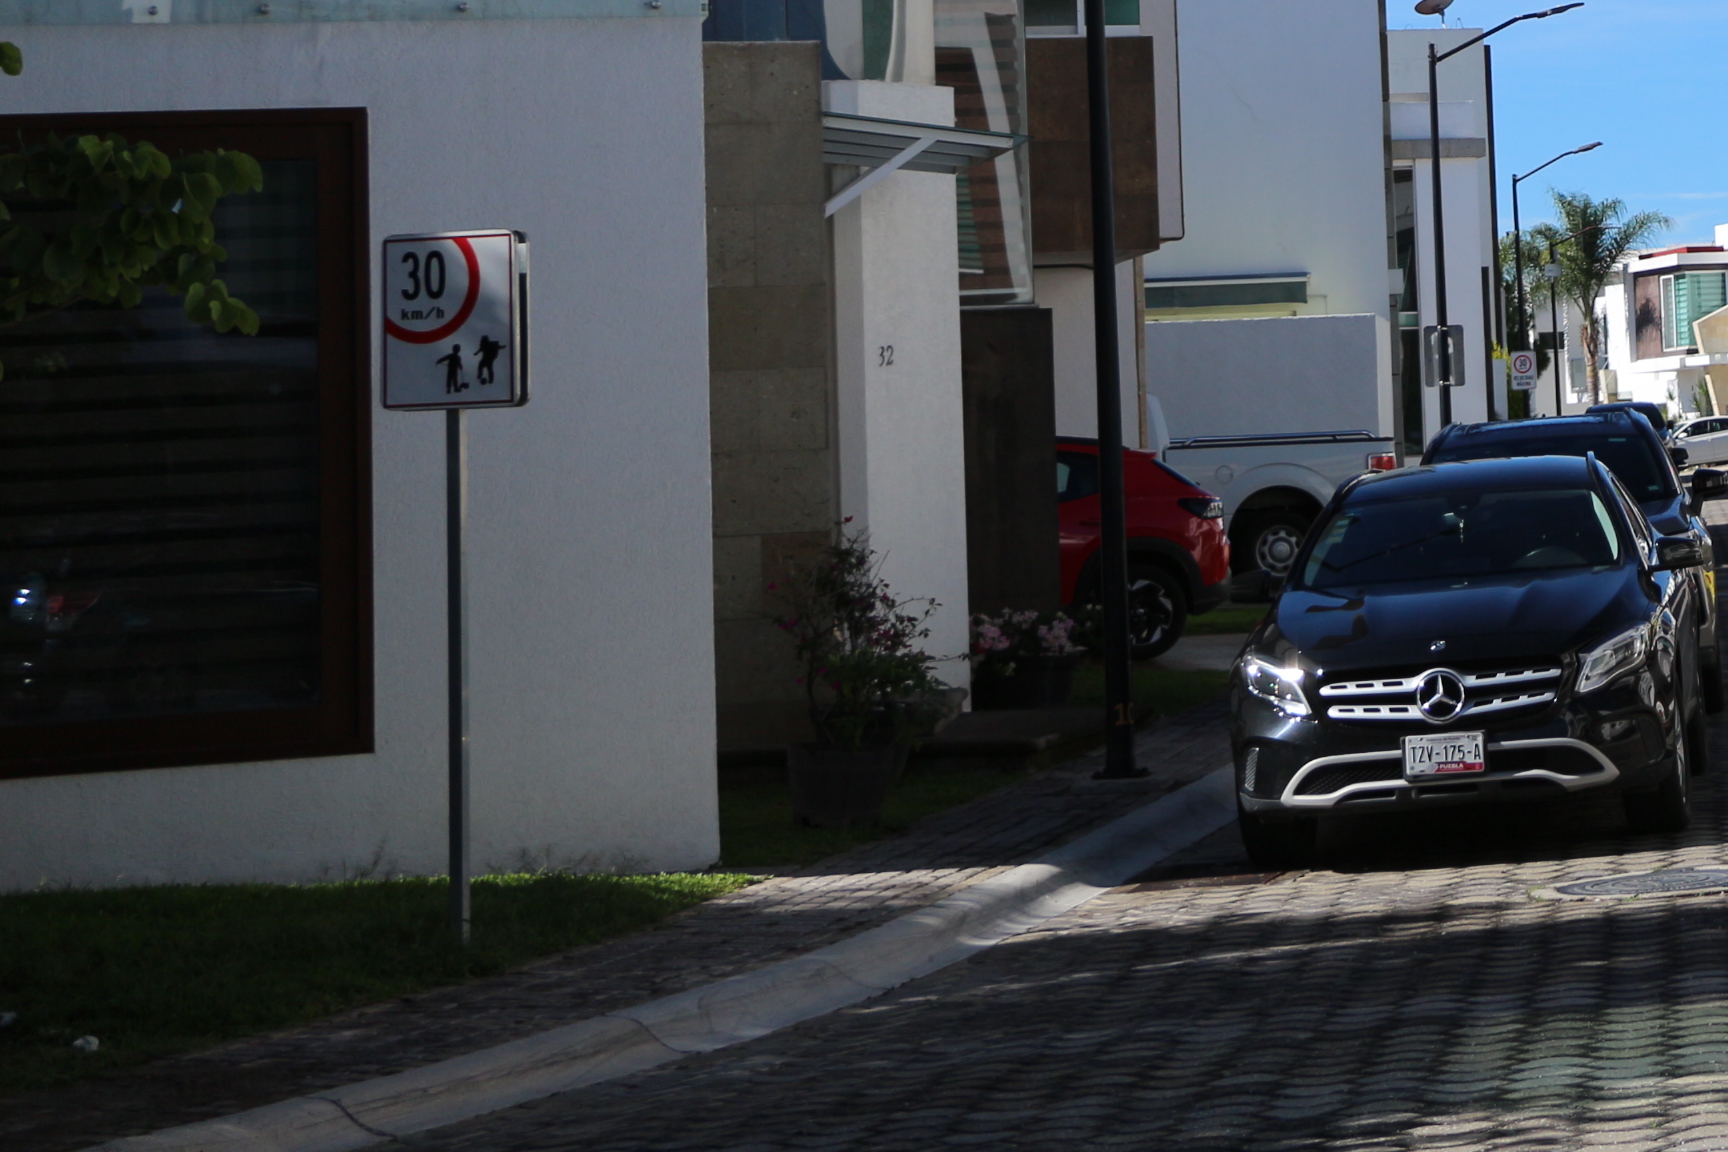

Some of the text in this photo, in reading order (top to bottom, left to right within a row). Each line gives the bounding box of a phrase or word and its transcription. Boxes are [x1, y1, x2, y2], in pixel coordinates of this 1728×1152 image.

[401, 250, 446, 301] 30
[401, 306, 445, 321] km/h
[879, 344, 894, 367] 32
[1518, 358, 1528, 367] 30
[1409, 743, 1481, 763] TZV-175-A
